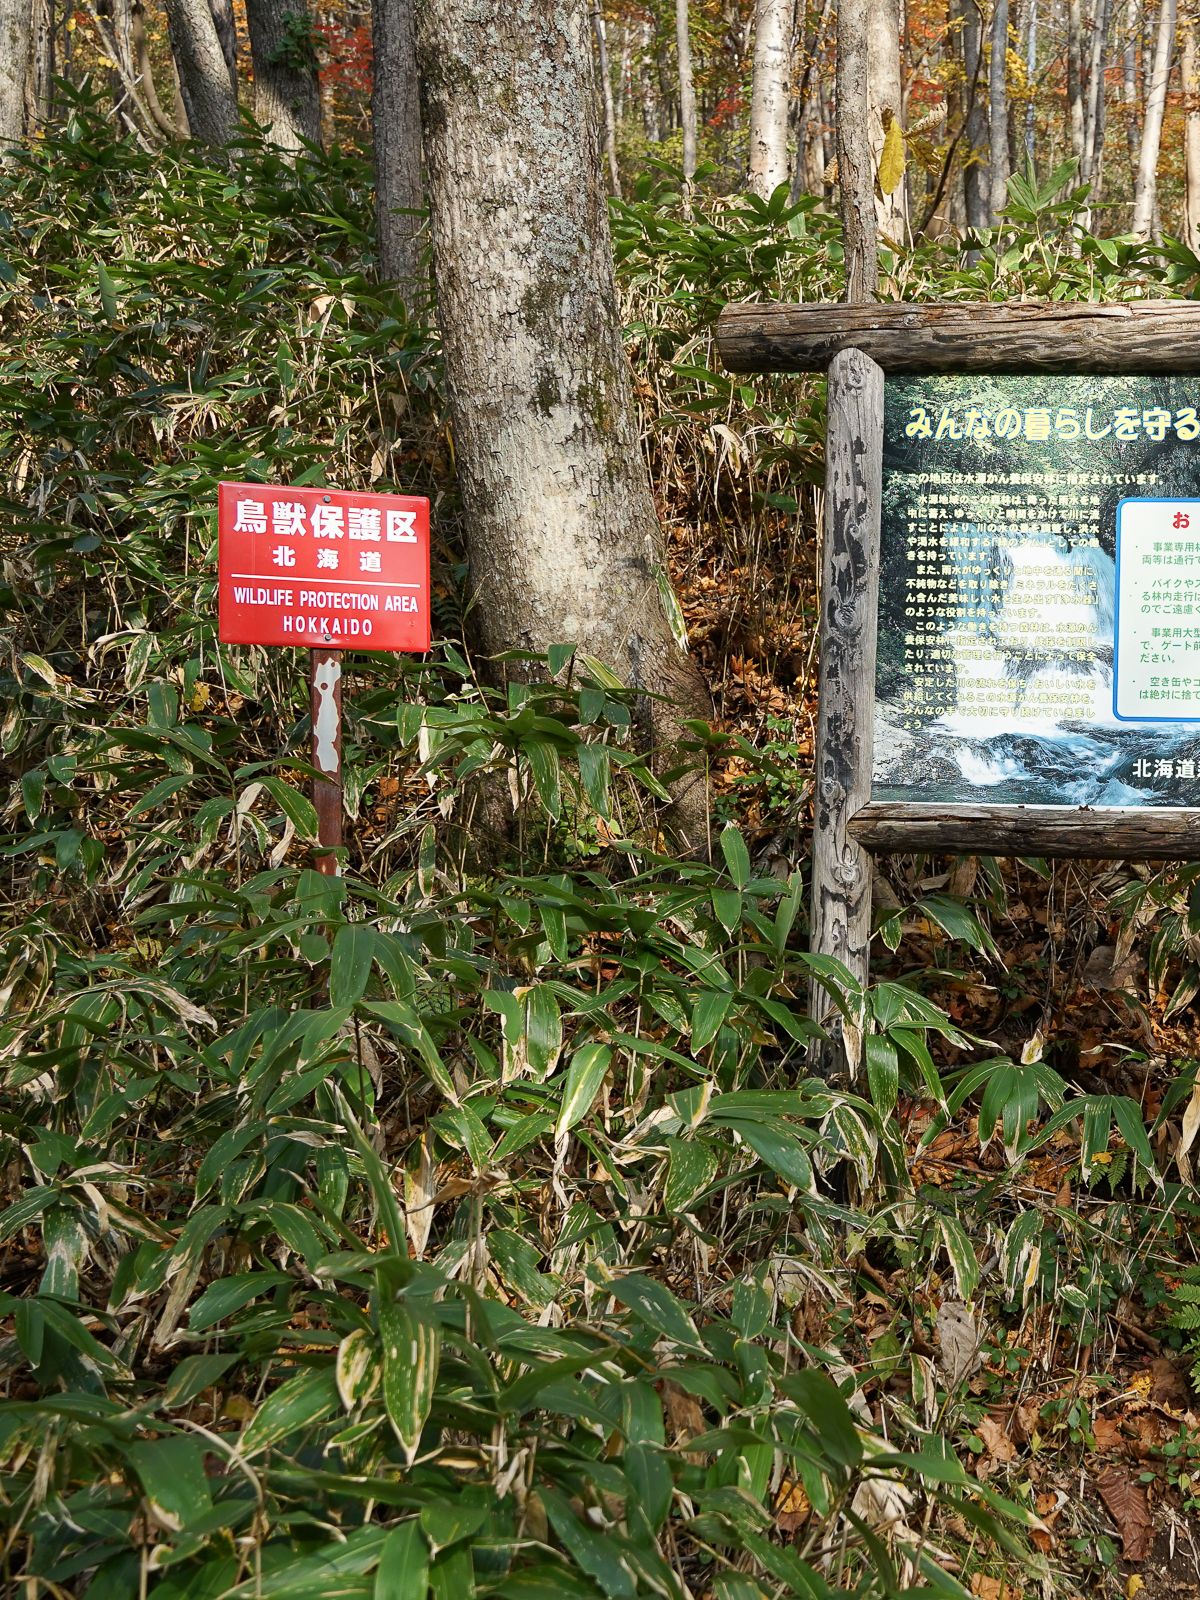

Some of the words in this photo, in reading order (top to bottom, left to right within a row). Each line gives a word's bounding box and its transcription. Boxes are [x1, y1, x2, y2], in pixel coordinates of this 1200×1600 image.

[233, 499, 417, 543] 鳥獣保護区
[272, 546, 382, 572] 北海道
[233, 587, 294, 607] WILDLIFE
[300, 590, 379, 611] PROTECTION
[384, 595, 419, 612] AREA
[283, 616, 373, 636] HOKKAIDO
[1140, 653, 1176, 663] ださい。
